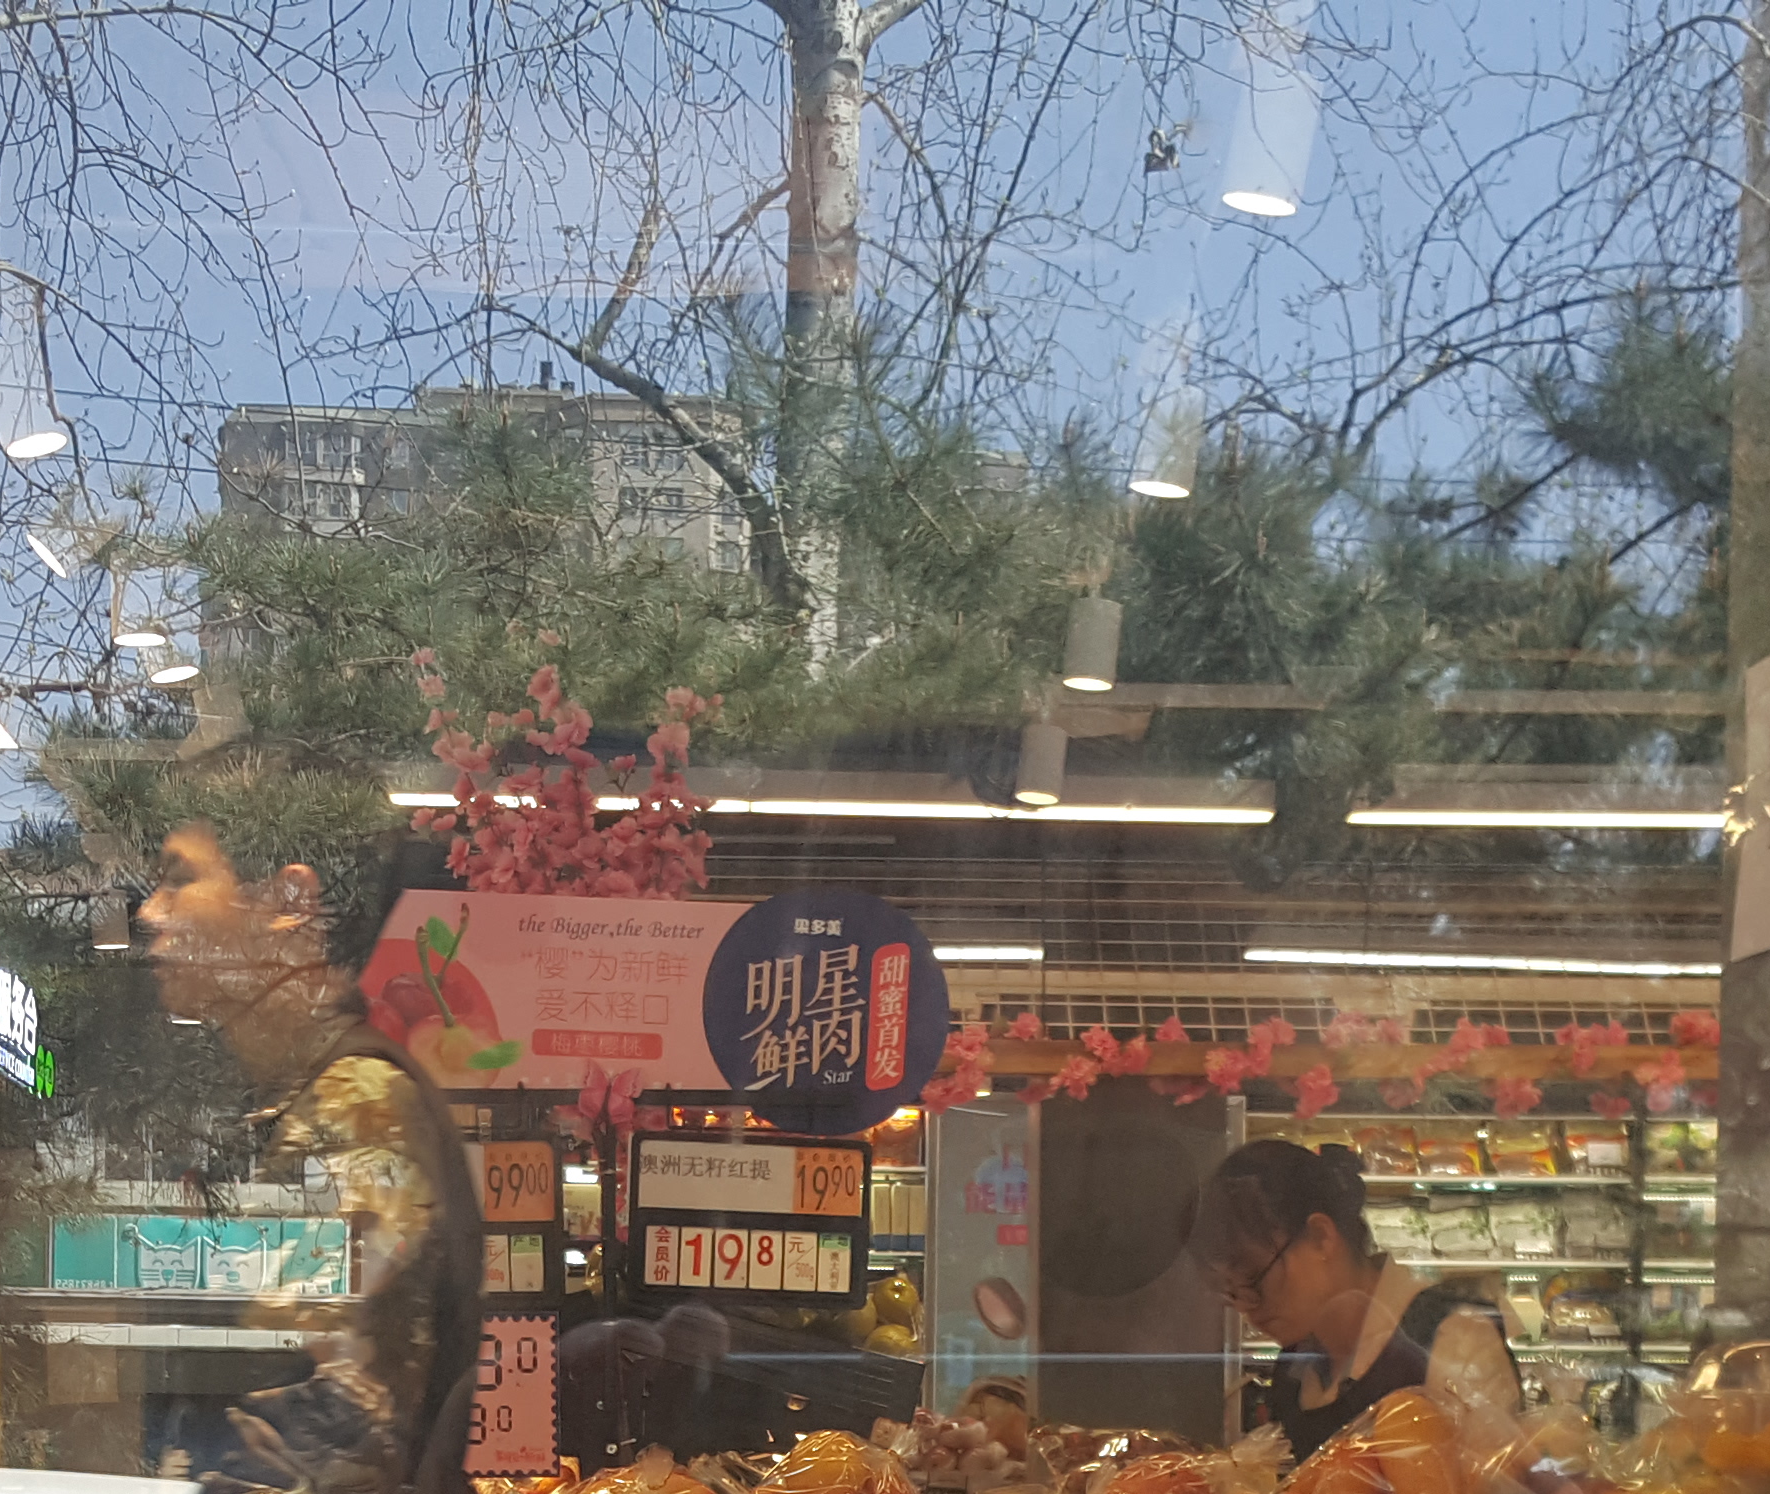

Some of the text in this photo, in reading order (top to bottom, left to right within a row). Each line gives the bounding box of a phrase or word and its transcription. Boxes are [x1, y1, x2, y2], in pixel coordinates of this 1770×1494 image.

[519, 914, 546, 933] the
[648, 921, 705, 939] Better
[535, 988, 670, 1025] 爱不释口
[871, 954, 909, 1080] 甜蜜首发
[822, 1069, 854, 1085] Star
[640, 1153, 772, 1182] 澳洲无籽红提
[654, 1226, 671, 1283] 会员价
